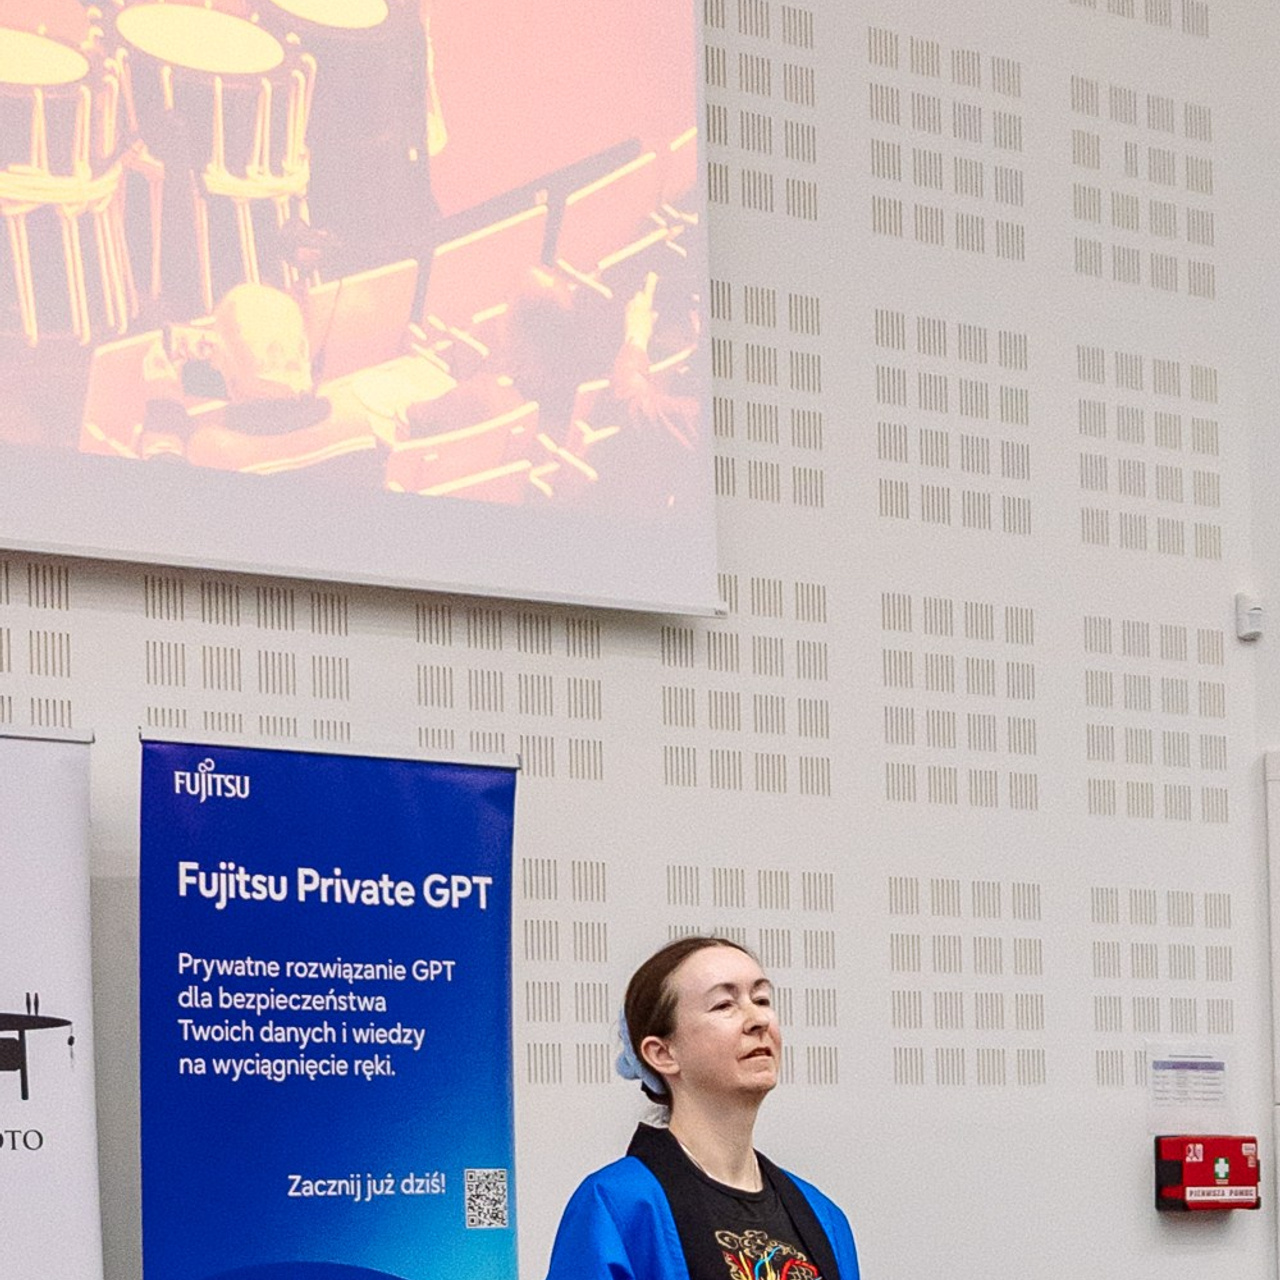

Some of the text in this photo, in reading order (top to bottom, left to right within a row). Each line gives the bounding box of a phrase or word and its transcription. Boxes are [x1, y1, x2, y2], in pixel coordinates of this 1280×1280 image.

[174, 758, 250, 803] FUJITSU
[178, 861, 493, 910] Fujitsu Private GPT
[178, 952, 456, 984] Prywatne rozwiązanie GPT
[178, 985, 387, 1016] dla bezpieczeństwa
[177, 1018, 426, 1051] Twoich danych i wiedzy
[179, 1053, 397, 1082] na wyciągnięcie ręki.
[0, 1129, 45, 1151] TO
[287, 1171, 447, 1202] Zacznij już dziś!
